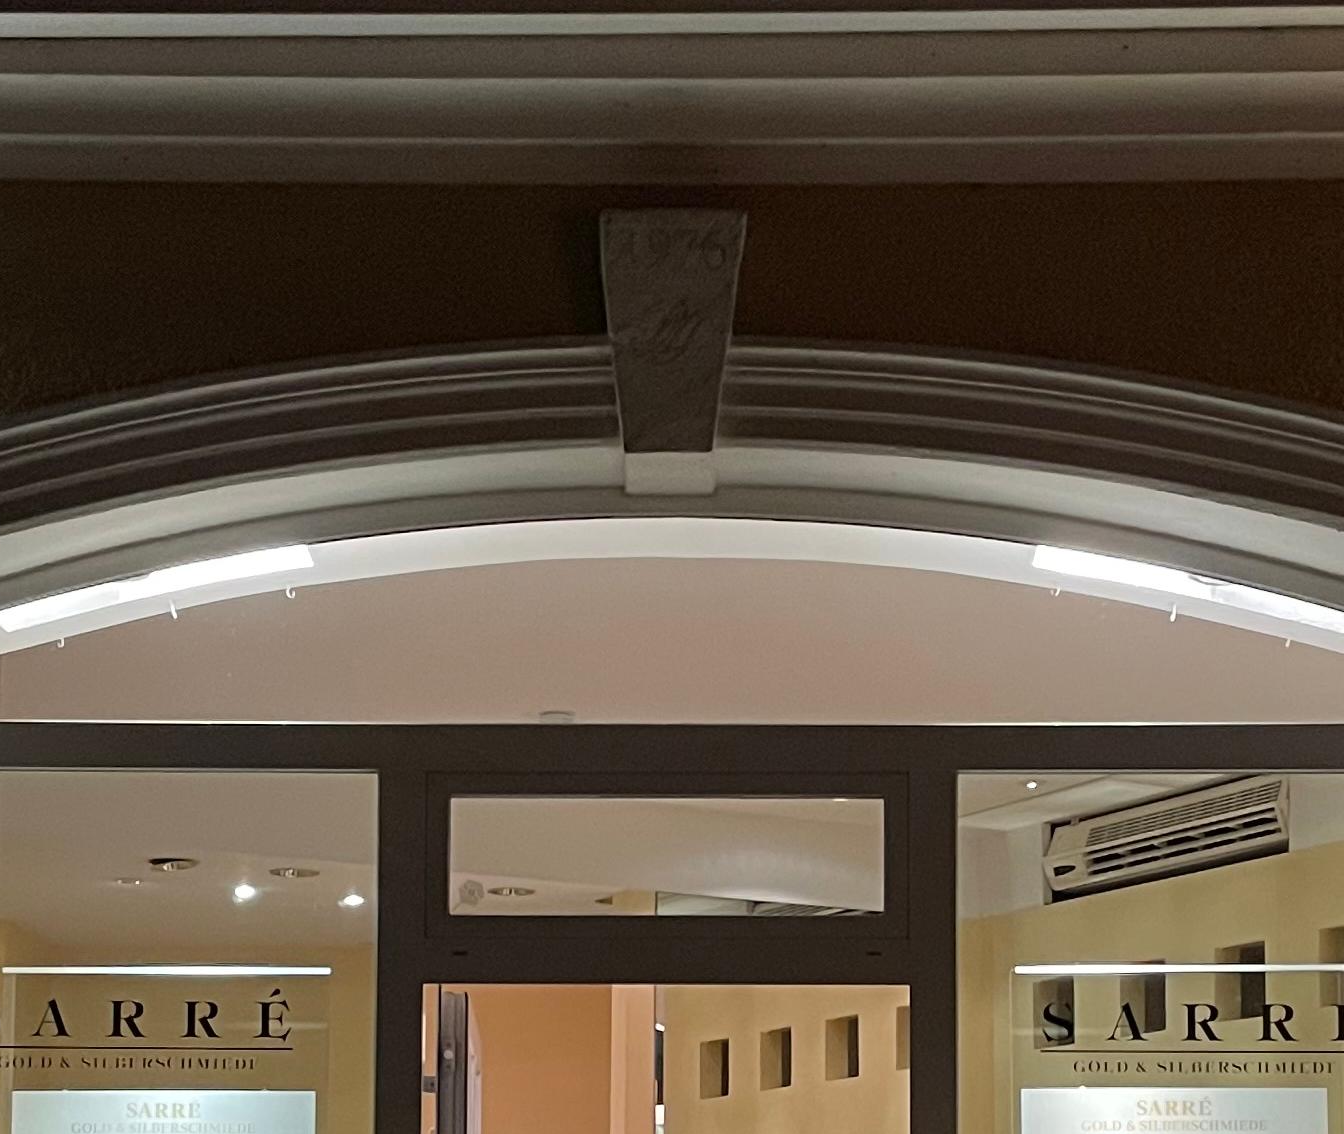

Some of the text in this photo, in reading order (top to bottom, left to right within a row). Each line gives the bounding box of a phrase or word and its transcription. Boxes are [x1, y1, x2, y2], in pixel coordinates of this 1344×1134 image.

[59, 1057, 71, 1070] &
[81, 1057, 258, 1071] SILBERSCHMIEDE
[1073, 1060, 1337, 1075] GOLD & SILBERSCHMIEDE
[125, 1101, 201, 1120] SARRÉ
[1136, 1096, 1213, 1117] SARRÉ
[71, 1122, 114, 1134] GOLD
[1081, 1120, 1123, 1132] GOLD
[1126, 1120, 1136, 1132] &
